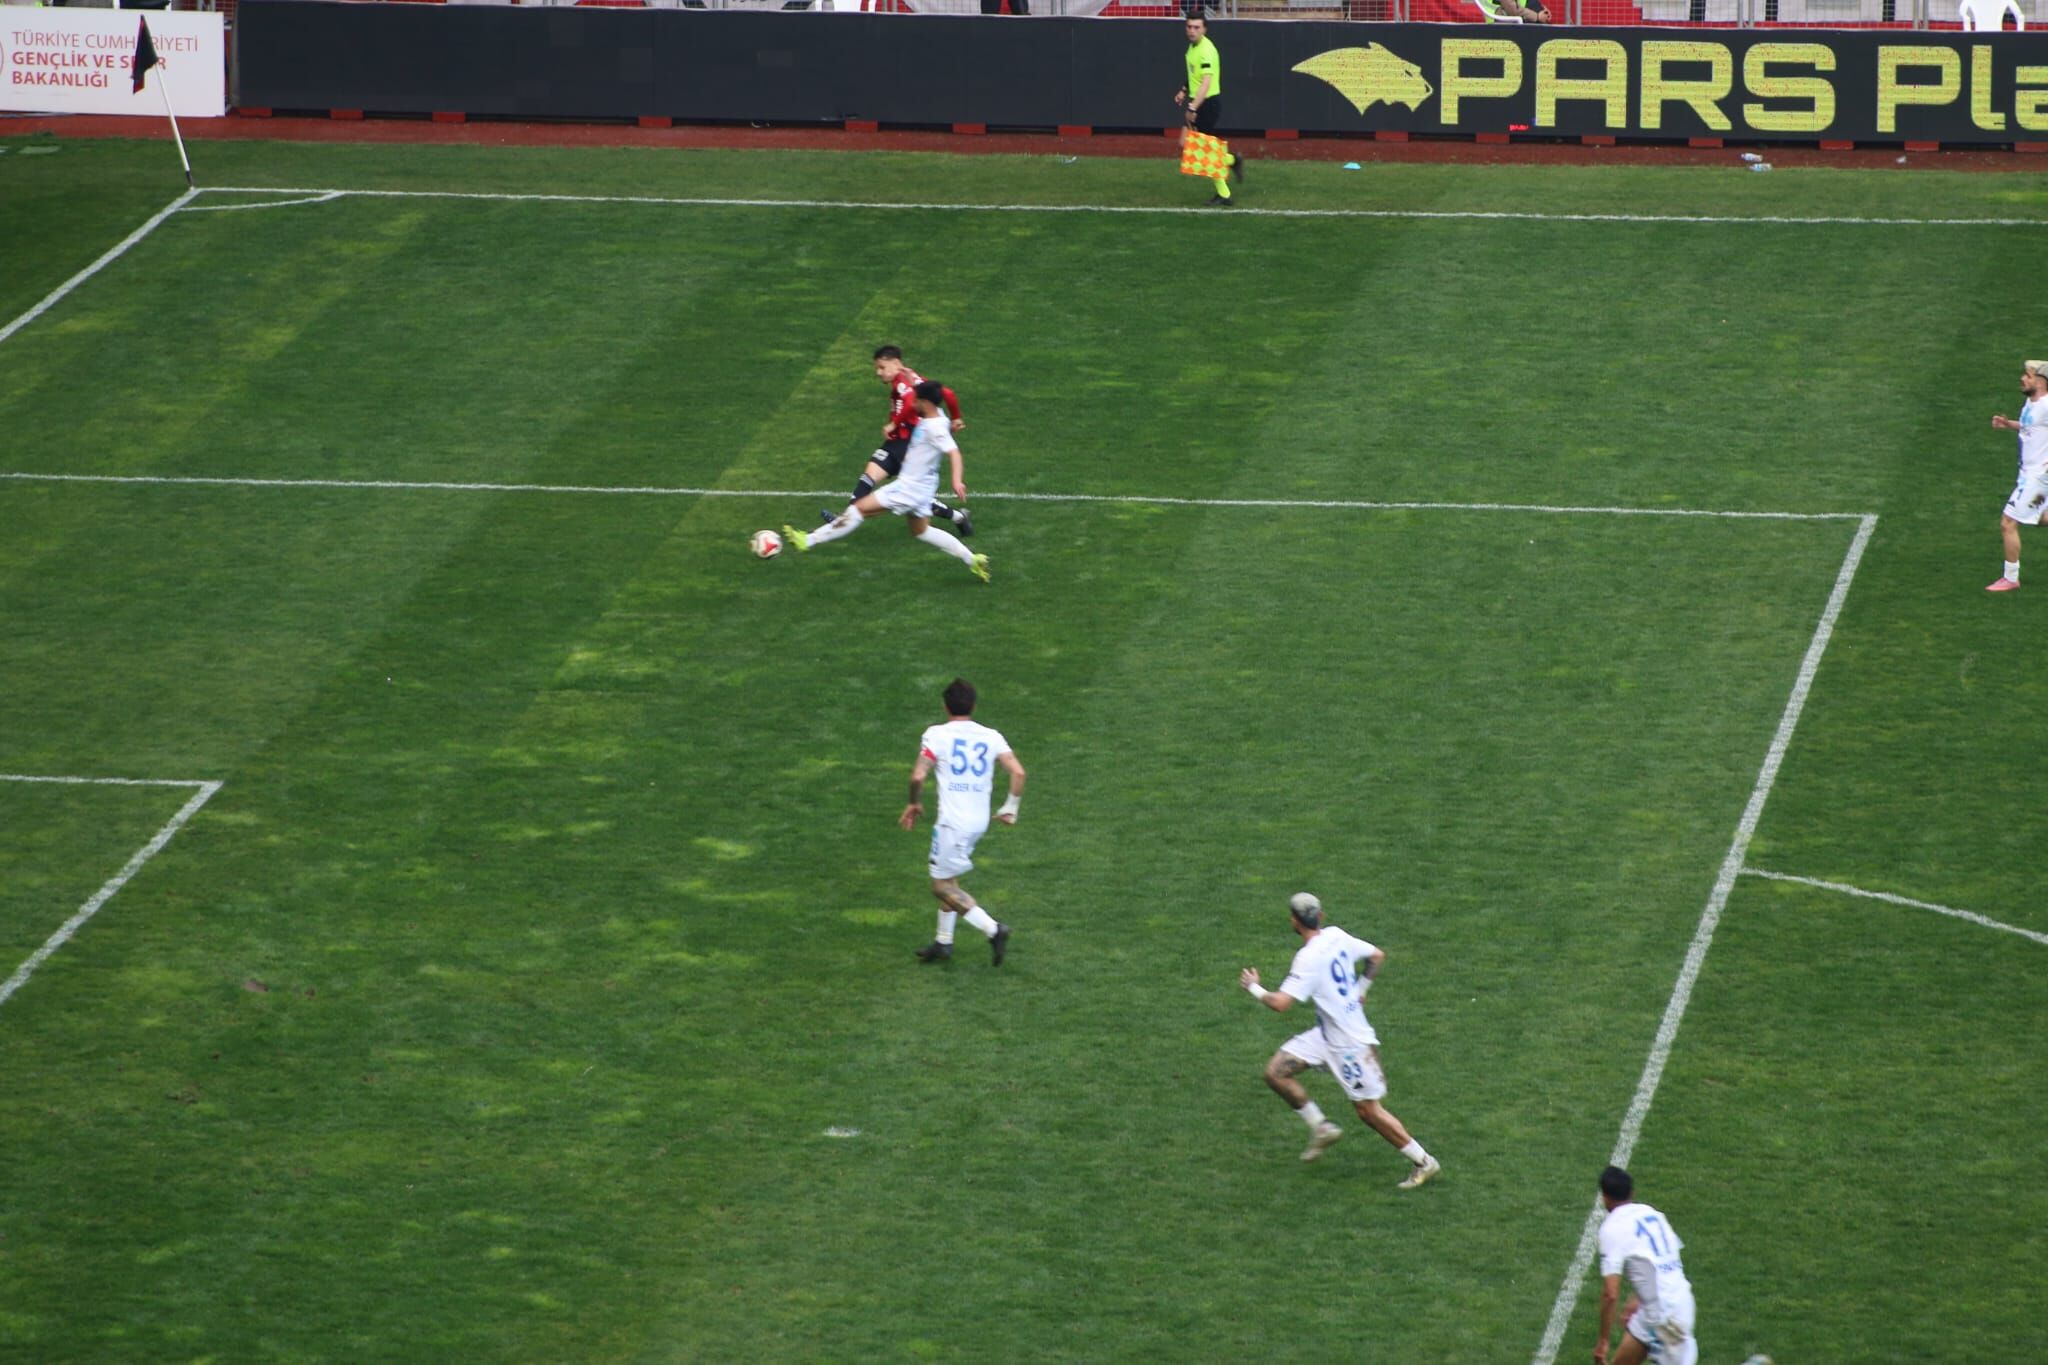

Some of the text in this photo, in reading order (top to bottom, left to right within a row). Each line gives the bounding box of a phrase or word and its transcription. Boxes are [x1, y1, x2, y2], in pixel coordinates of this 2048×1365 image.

[12, 30, 198, 51] TÜRKİYE CUMHRİYETİ
[12, 51, 166, 70] GENÇLİK VE SR
[12, 71, 108, 87] BAKANLIĞI
[1440, 38, 1836, 132] PARS
[950, 738, 988, 777] 53
[1635, 1215, 1671, 1256] 17
